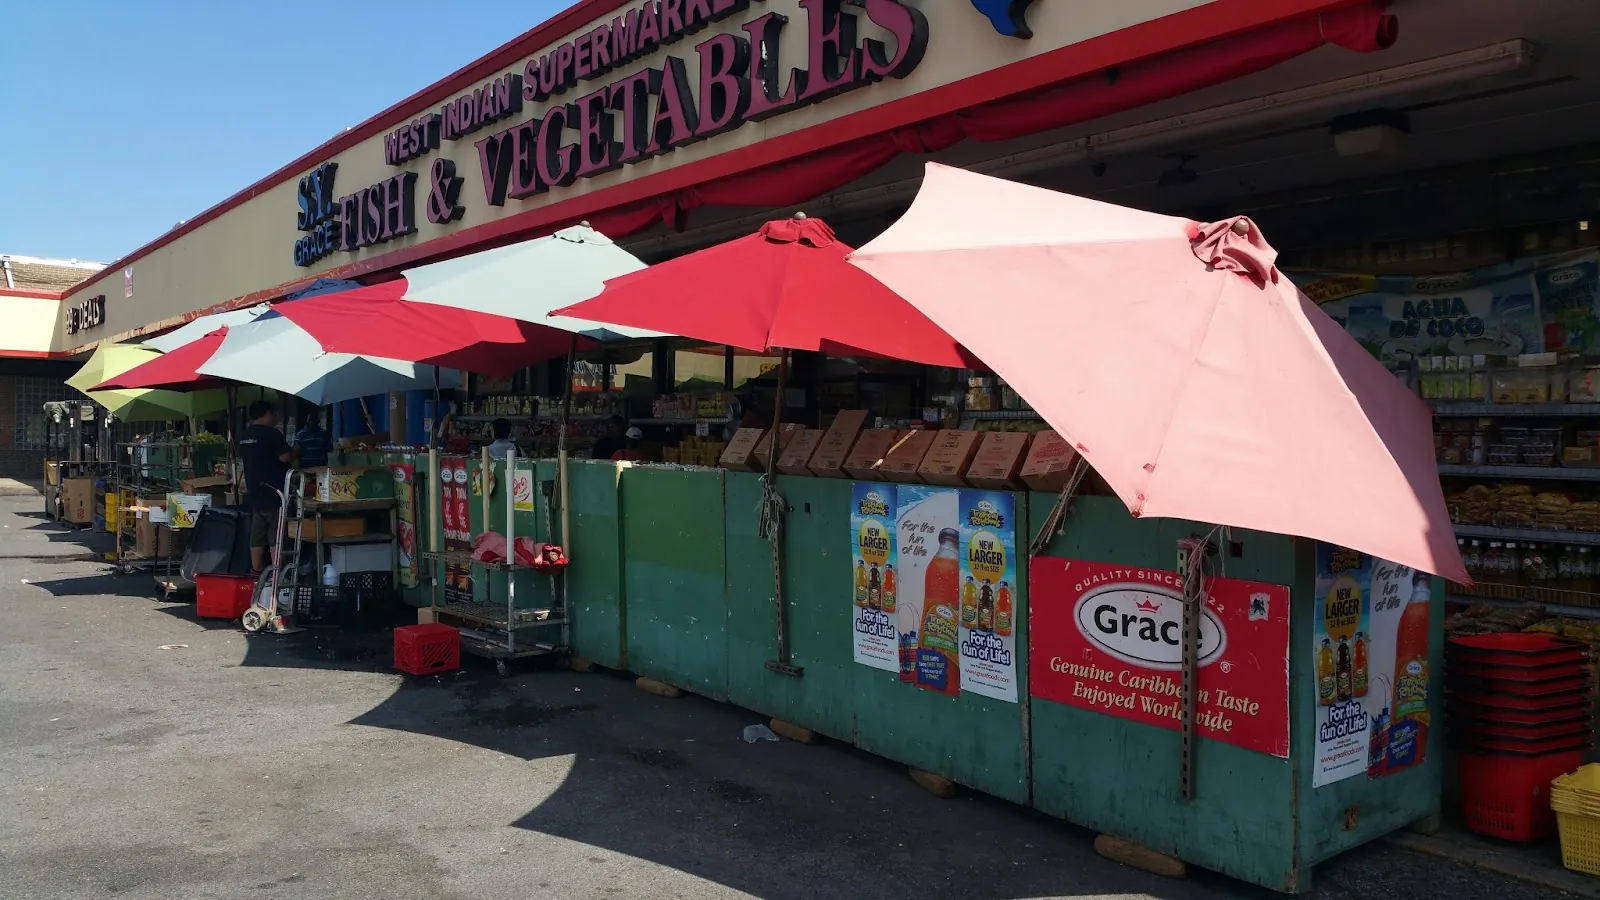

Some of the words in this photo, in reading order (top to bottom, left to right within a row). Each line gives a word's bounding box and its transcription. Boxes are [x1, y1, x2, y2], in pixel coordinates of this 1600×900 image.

[384, 114, 436, 165] WEST
[441, 73, 516, 140] INDIAN
[523, 0, 740, 101] SUPERMARK
[339, 171, 412, 251] FISH
[427, 158, 458, 224] &
[474, 0, 916, 206] VEGETABLES
[294, 221, 334, 267] GRACE
[1552, 272, 1580, 282] Grace
[859, 535, 888, 551] LARGER
[867, 528, 880, 537] NEW
[979, 540, 993, 551] NEW
[969, 549, 1003, 566] LARGER
[1075, 570, 1131, 592] QUALITY
[1138, 570, 1183, 588] SINCE
[1336, 587, 1351, 601] NEW
[862, 608, 874, 622] For
[875, 611, 888, 626] the
[1325, 599, 1359, 619] LARGER
[856, 618, 868, 633] fun
[878, 624, 894, 639] Life!
[970, 629, 985, 646] For
[986, 633, 1002, 649] the
[962, 641, 978, 658] fun
[989, 648, 1010, 666] Life!
[1050, 656, 1114, 683] Genuine
[1118, 669, 1209, 704] Caribben
[1216, 688, 1260, 716] Taste
[1072, 681, 1136, 709] Enjoyed
[1328, 704, 1345, 723] For
[1345, 700, 1361, 718] the
[1320, 722, 1336, 743] fun
[1348, 711, 1368, 734] Life!
